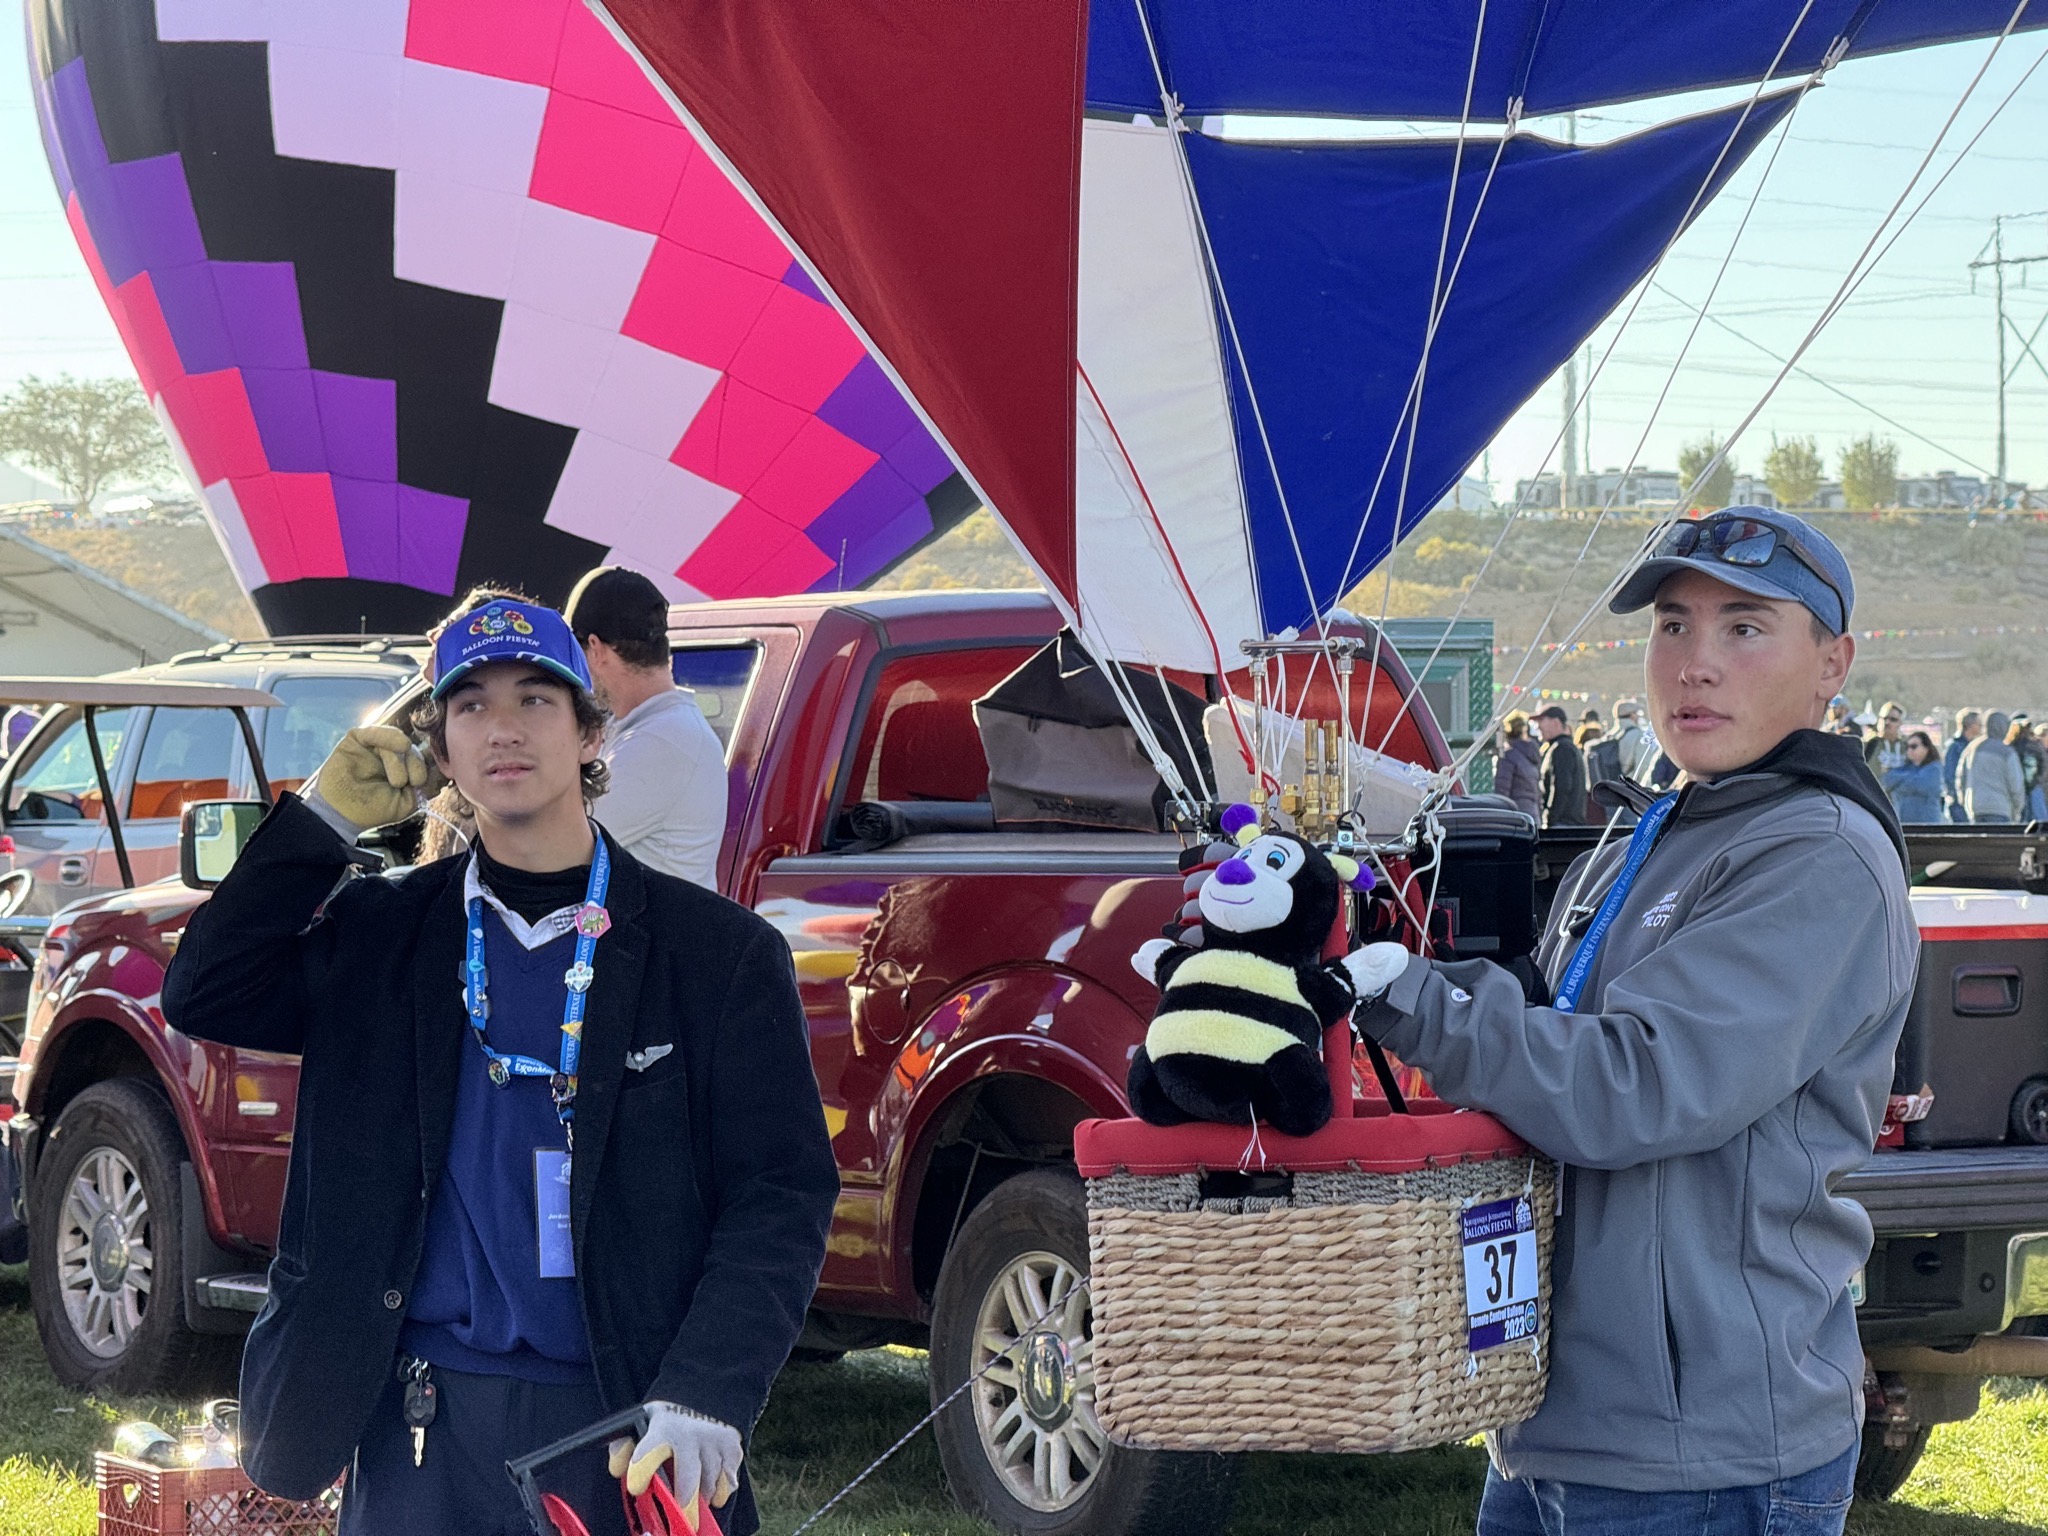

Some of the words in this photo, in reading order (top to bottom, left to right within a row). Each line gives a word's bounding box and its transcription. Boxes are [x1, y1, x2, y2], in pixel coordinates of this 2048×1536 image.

[462, 635, 504, 656] BALLOON
[1641, 914, 1670, 928] PILOT
[1564, 941, 1595, 997] ALBUQUERQUE
[1590, 886, 1625, 944] INTERNATIONAL
[1464, 1223, 1490, 1239] BALLOON
[1491, 1219, 1512, 1233] FIESTA
[1484, 1240, 1517, 1304] 37
[1470, 1313, 1489, 1329] Remote
[1489, 1307, 1507, 1324] Control
[1504, 1315, 1525, 1341] 2023
